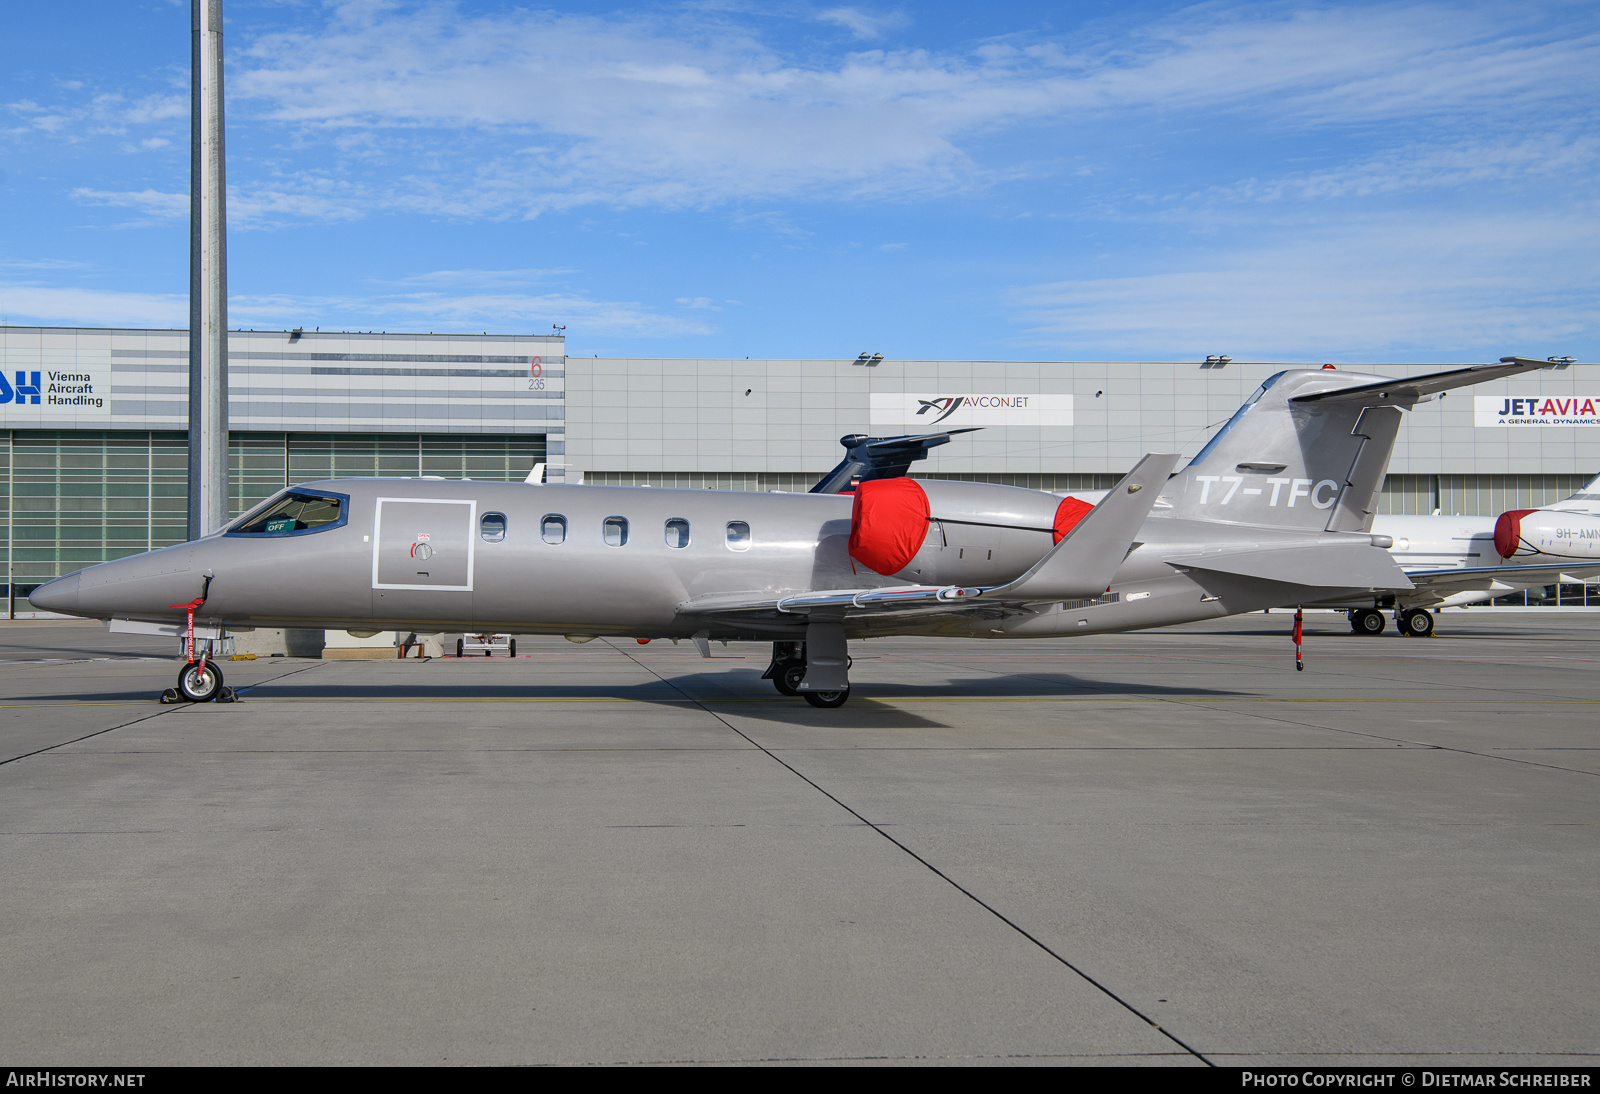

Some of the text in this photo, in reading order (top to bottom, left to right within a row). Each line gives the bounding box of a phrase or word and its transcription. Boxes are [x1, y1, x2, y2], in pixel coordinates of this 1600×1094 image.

[531, 356, 541, 377] 6
[47, 371, 91, 381] Vienna
[47, 383, 93, 393] Aircraft
[528, 379, 545, 390] 235
[47, 395, 103, 407] Handling
[963, 397, 1028, 407] AVCONJET
[1196, 476, 1338, 510] T7-TFC
[268, 523, 285, 531] OFF
